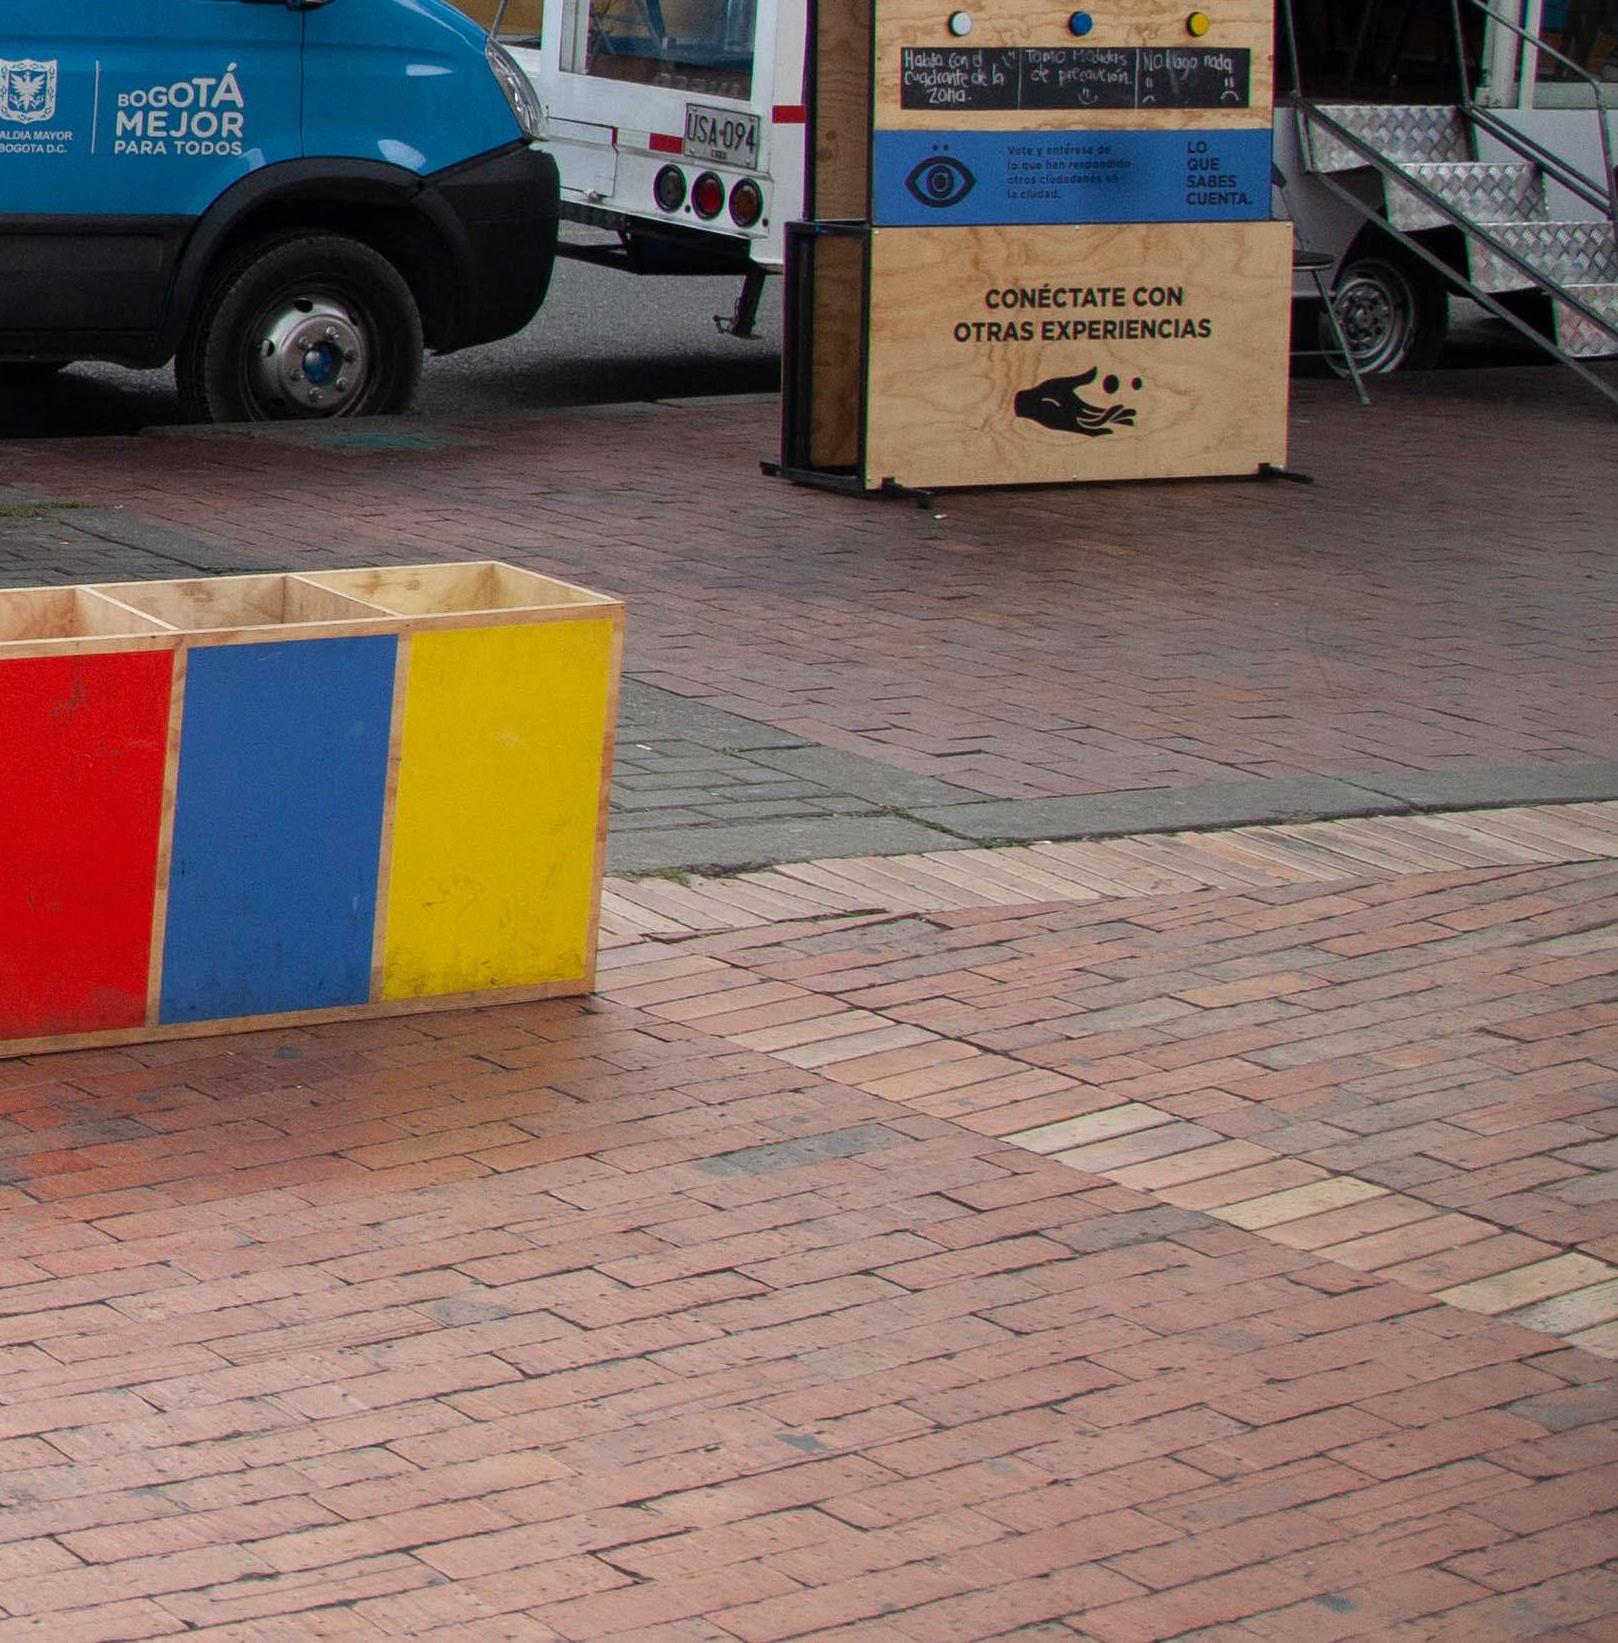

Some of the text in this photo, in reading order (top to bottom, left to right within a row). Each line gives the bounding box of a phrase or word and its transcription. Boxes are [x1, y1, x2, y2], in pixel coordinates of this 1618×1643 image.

[118, 61, 244, 108] BOGOTÁ
[116, 111, 244, 139] MEJOR
[34, 131, 74, 141] MAYOR
[114, 141, 242, 155] PARA TODOS
[1008, 145, 1032, 155] Vote
[1037, 147, 1043, 157] y
[1187, 141, 1207, 154] LO
[1022, 162, 1042, 173] que
[1046, 160, 1064, 169] han
[1187, 157, 1220, 171] QUE
[1007, 175, 1036, 185] otros
[1040, 175, 1102, 185] ciudadanos
[1186, 175, 1236, 188] SABES
[1187, 192, 1253, 205] CUENTA.
[984, 283, 1184, 311] CONÉCTATE CON
[954, 318, 1212, 343] OTRAS EXPERIENCIAS
